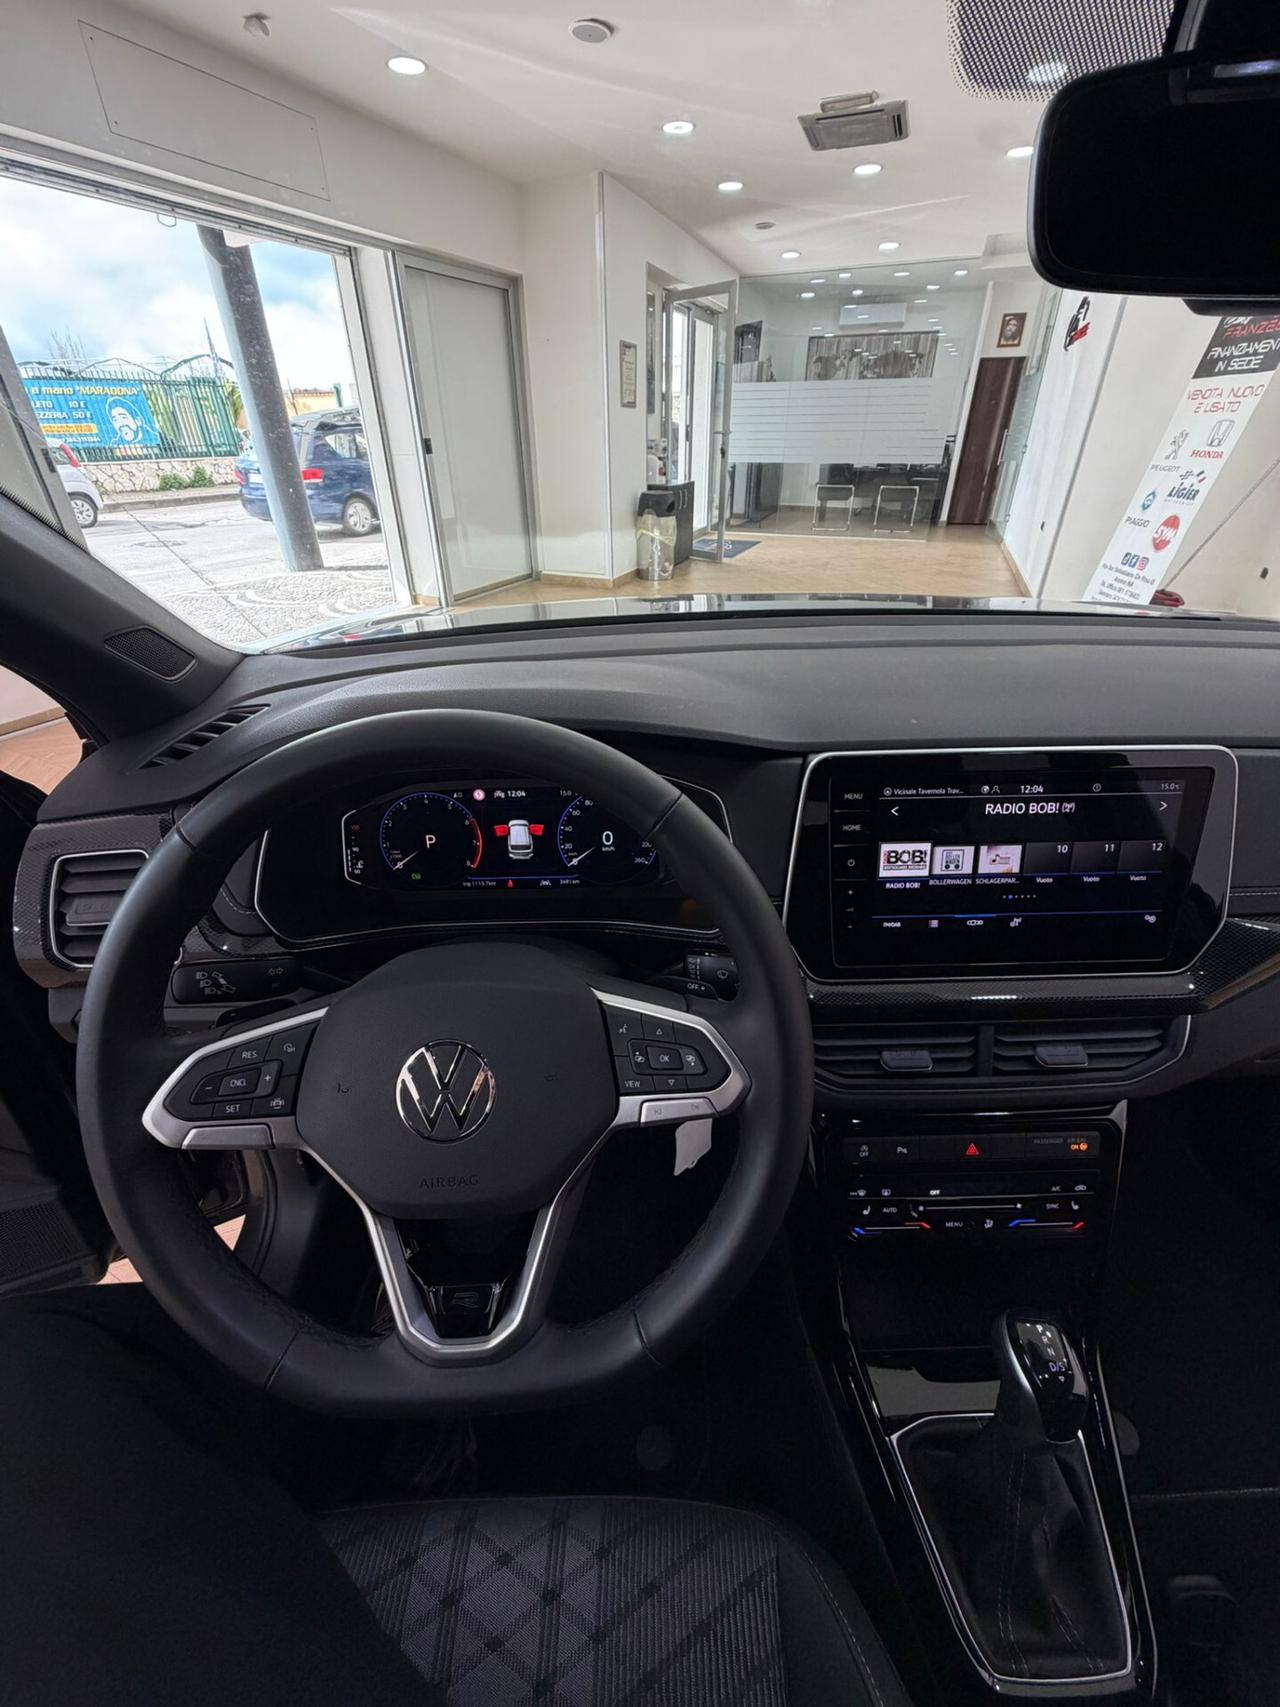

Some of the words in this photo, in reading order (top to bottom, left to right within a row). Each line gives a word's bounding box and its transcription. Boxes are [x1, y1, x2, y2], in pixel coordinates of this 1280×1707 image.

[1227, 355, 1264, 371] SEDE
[42, 386, 74, 396] mano
[1228, 384, 1265, 399] NUOVO
[68, 400, 79, 409] 10
[1204, 401, 1242, 413] USATO
[72, 411, 85, 419] 50
[1190, 449, 1224, 459] HONDA
[1150, 464, 1181, 472] PEUGEOT
[1020, 785, 1044, 794] 12:04
[985, 803, 1026, 815] RADIO
[1028, 802, 1060, 814] BOB!
[425, 834, 437, 848] P
[602, 831, 613, 845] 0
[1057, 845, 1069, 853] 10
[1104, 844, 1115, 853] 11
[1152, 842, 1163, 851] 12
[886, 849, 928, 864] BOB!
[241, 1050, 257, 1059] RES
[659, 1054, 670, 1062] OK
[230, 1078, 247, 1087] CNCL
[625, 1080, 641, 1088] VIEW
[225, 1104, 240, 1113] SET
[419, 1174, 479, 1190] AIRBAG
